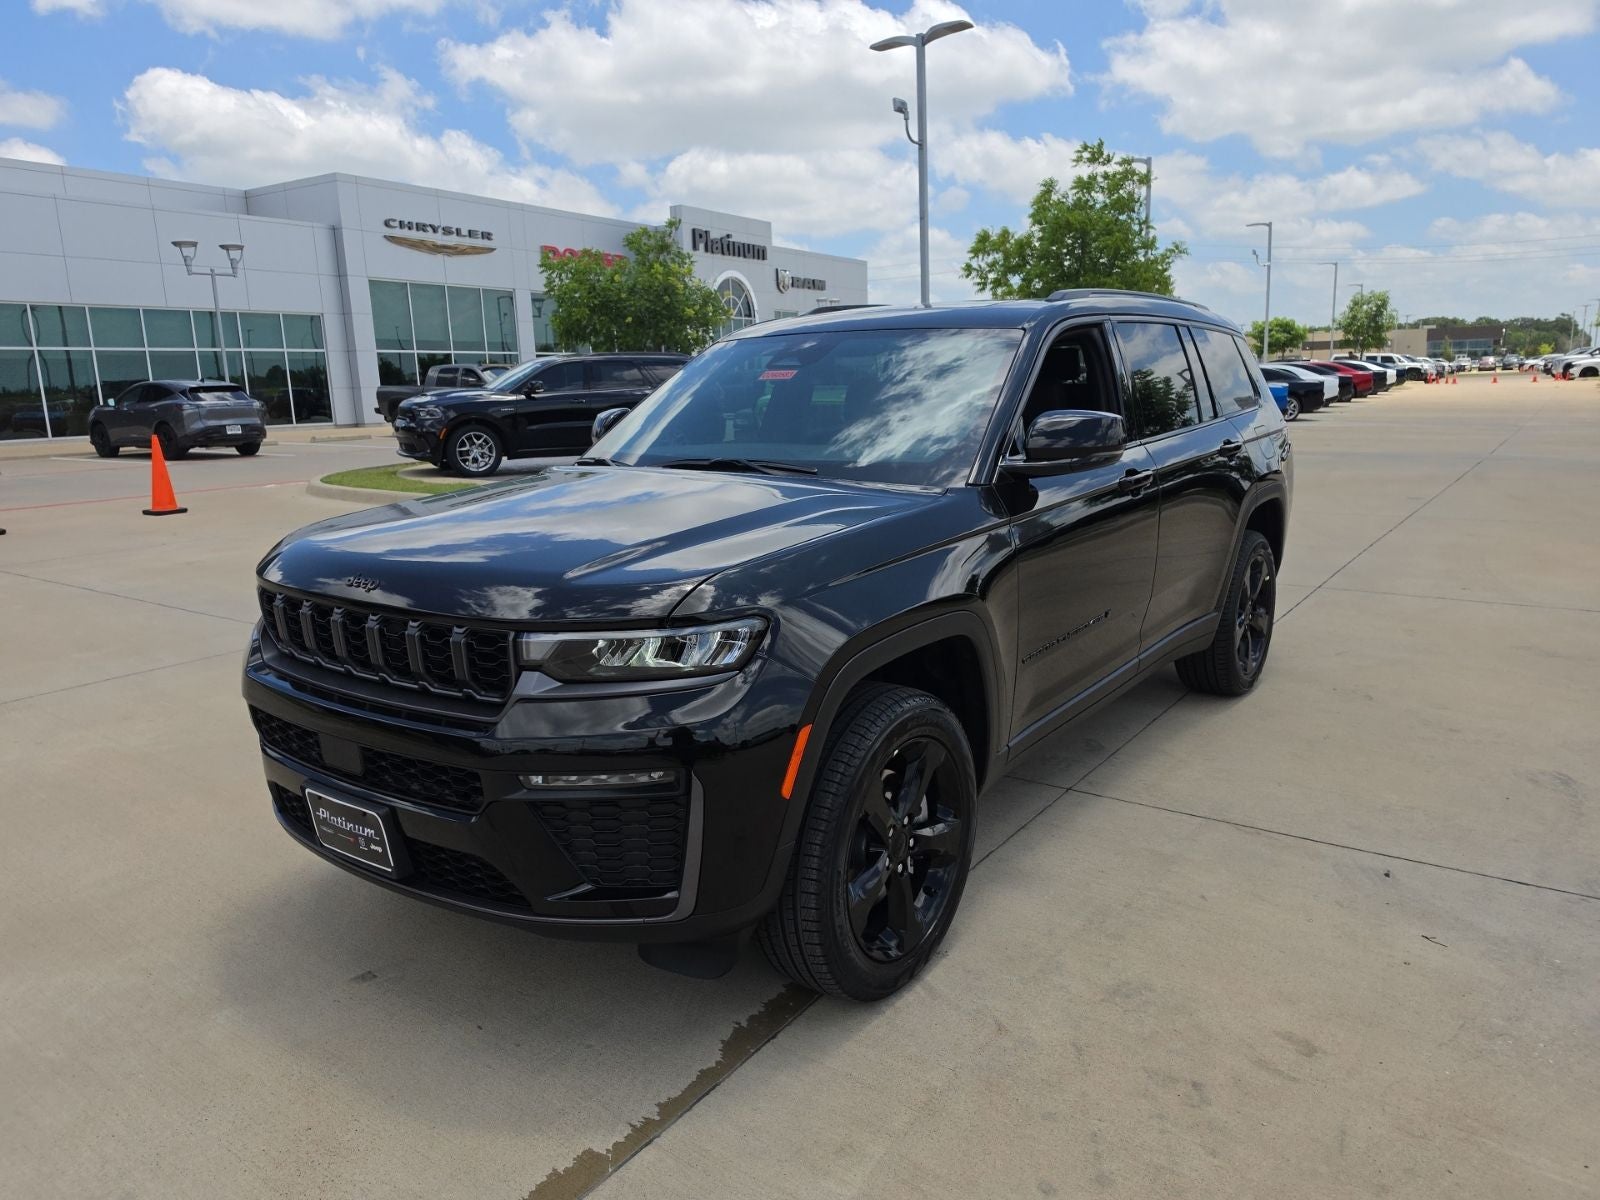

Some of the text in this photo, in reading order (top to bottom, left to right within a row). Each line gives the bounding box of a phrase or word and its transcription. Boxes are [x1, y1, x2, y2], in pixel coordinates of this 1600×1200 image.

[383, 217, 494, 241] CHRYSLER
[691, 227, 767, 261] Platinum
[791, 276, 826, 291] RAM
[346, 573, 380, 593] Jeep
[316, 807, 379, 840] Platinum
